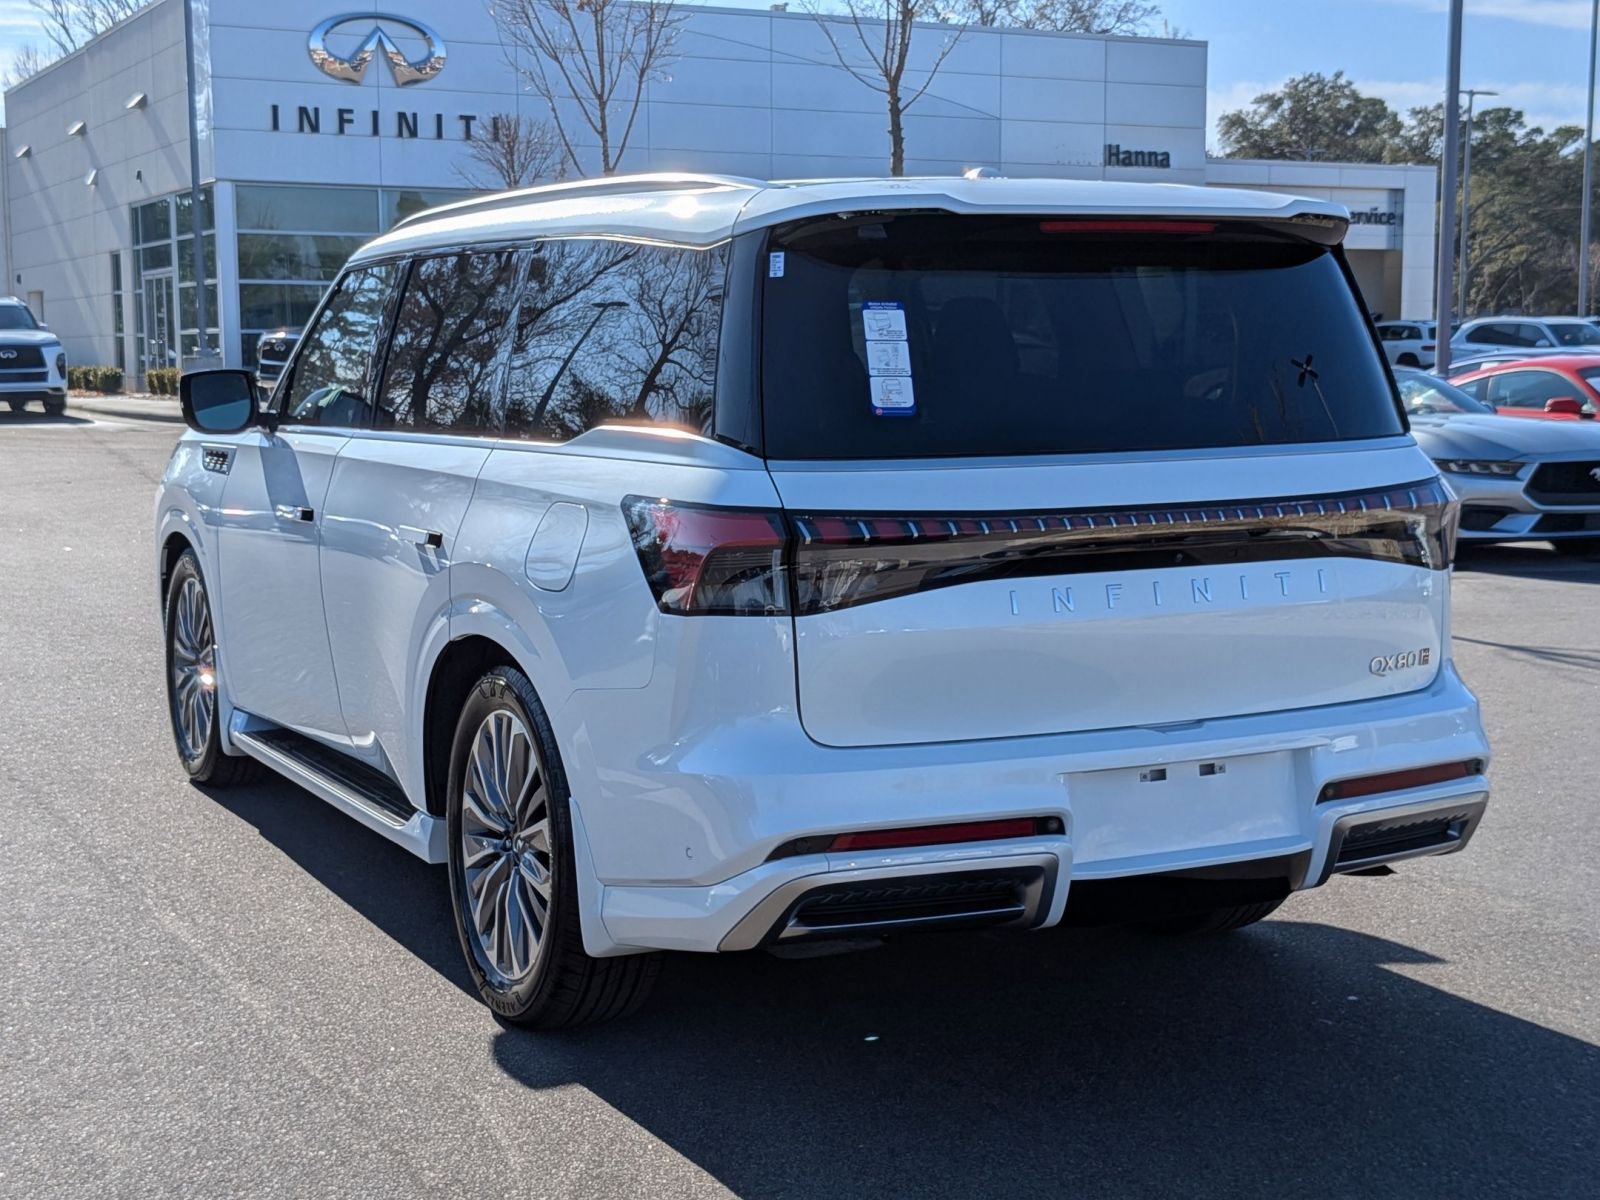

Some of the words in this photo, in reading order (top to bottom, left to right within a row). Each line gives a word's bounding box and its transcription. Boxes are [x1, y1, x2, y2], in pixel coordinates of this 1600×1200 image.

[271, 103, 501, 142] INFINITI
[1103, 144, 1170, 169] Hanna
[1349, 206, 1396, 226] ervice
[1009, 569, 1327, 616] INFINITI
[1369, 650, 1417, 677] QX80
